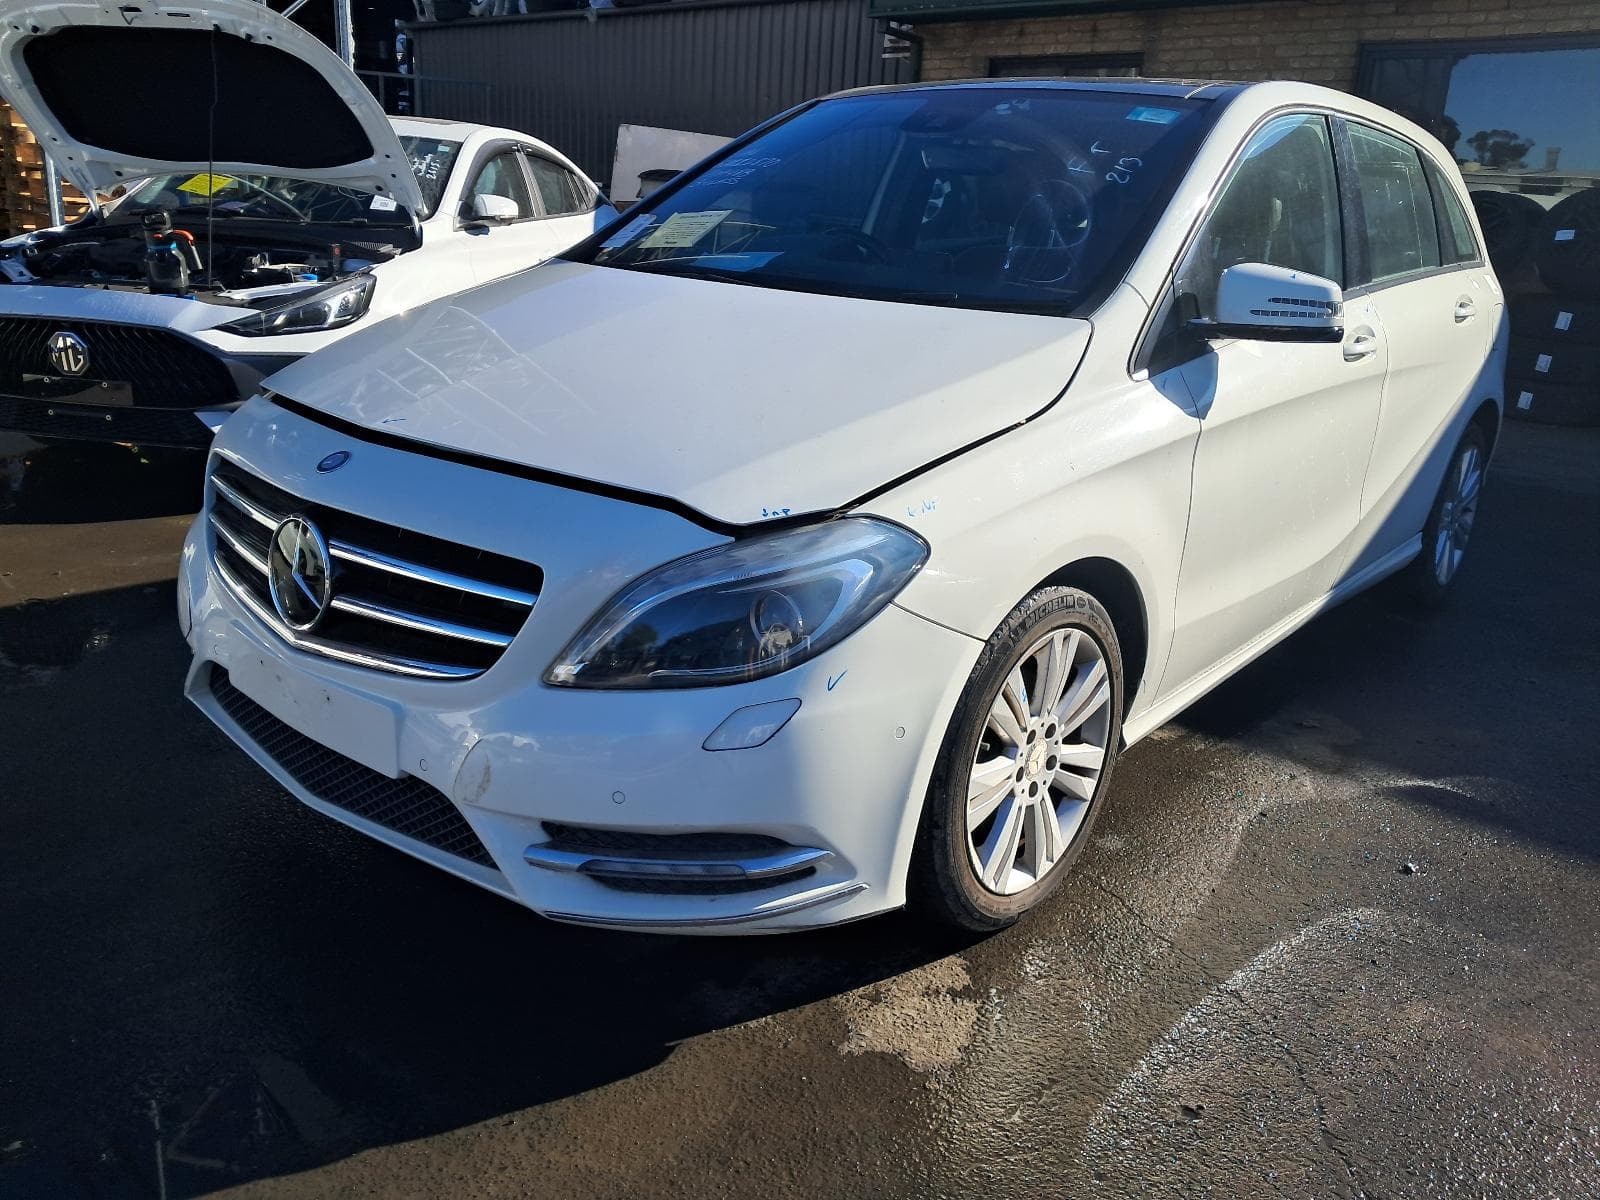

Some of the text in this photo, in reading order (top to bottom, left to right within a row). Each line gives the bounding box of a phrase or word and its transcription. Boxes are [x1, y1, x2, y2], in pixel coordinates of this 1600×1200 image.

[1105, 157, 1143, 184] 213
[50, 335, 85, 372] MG
[1024, 595, 1076, 629] MICHELIN
